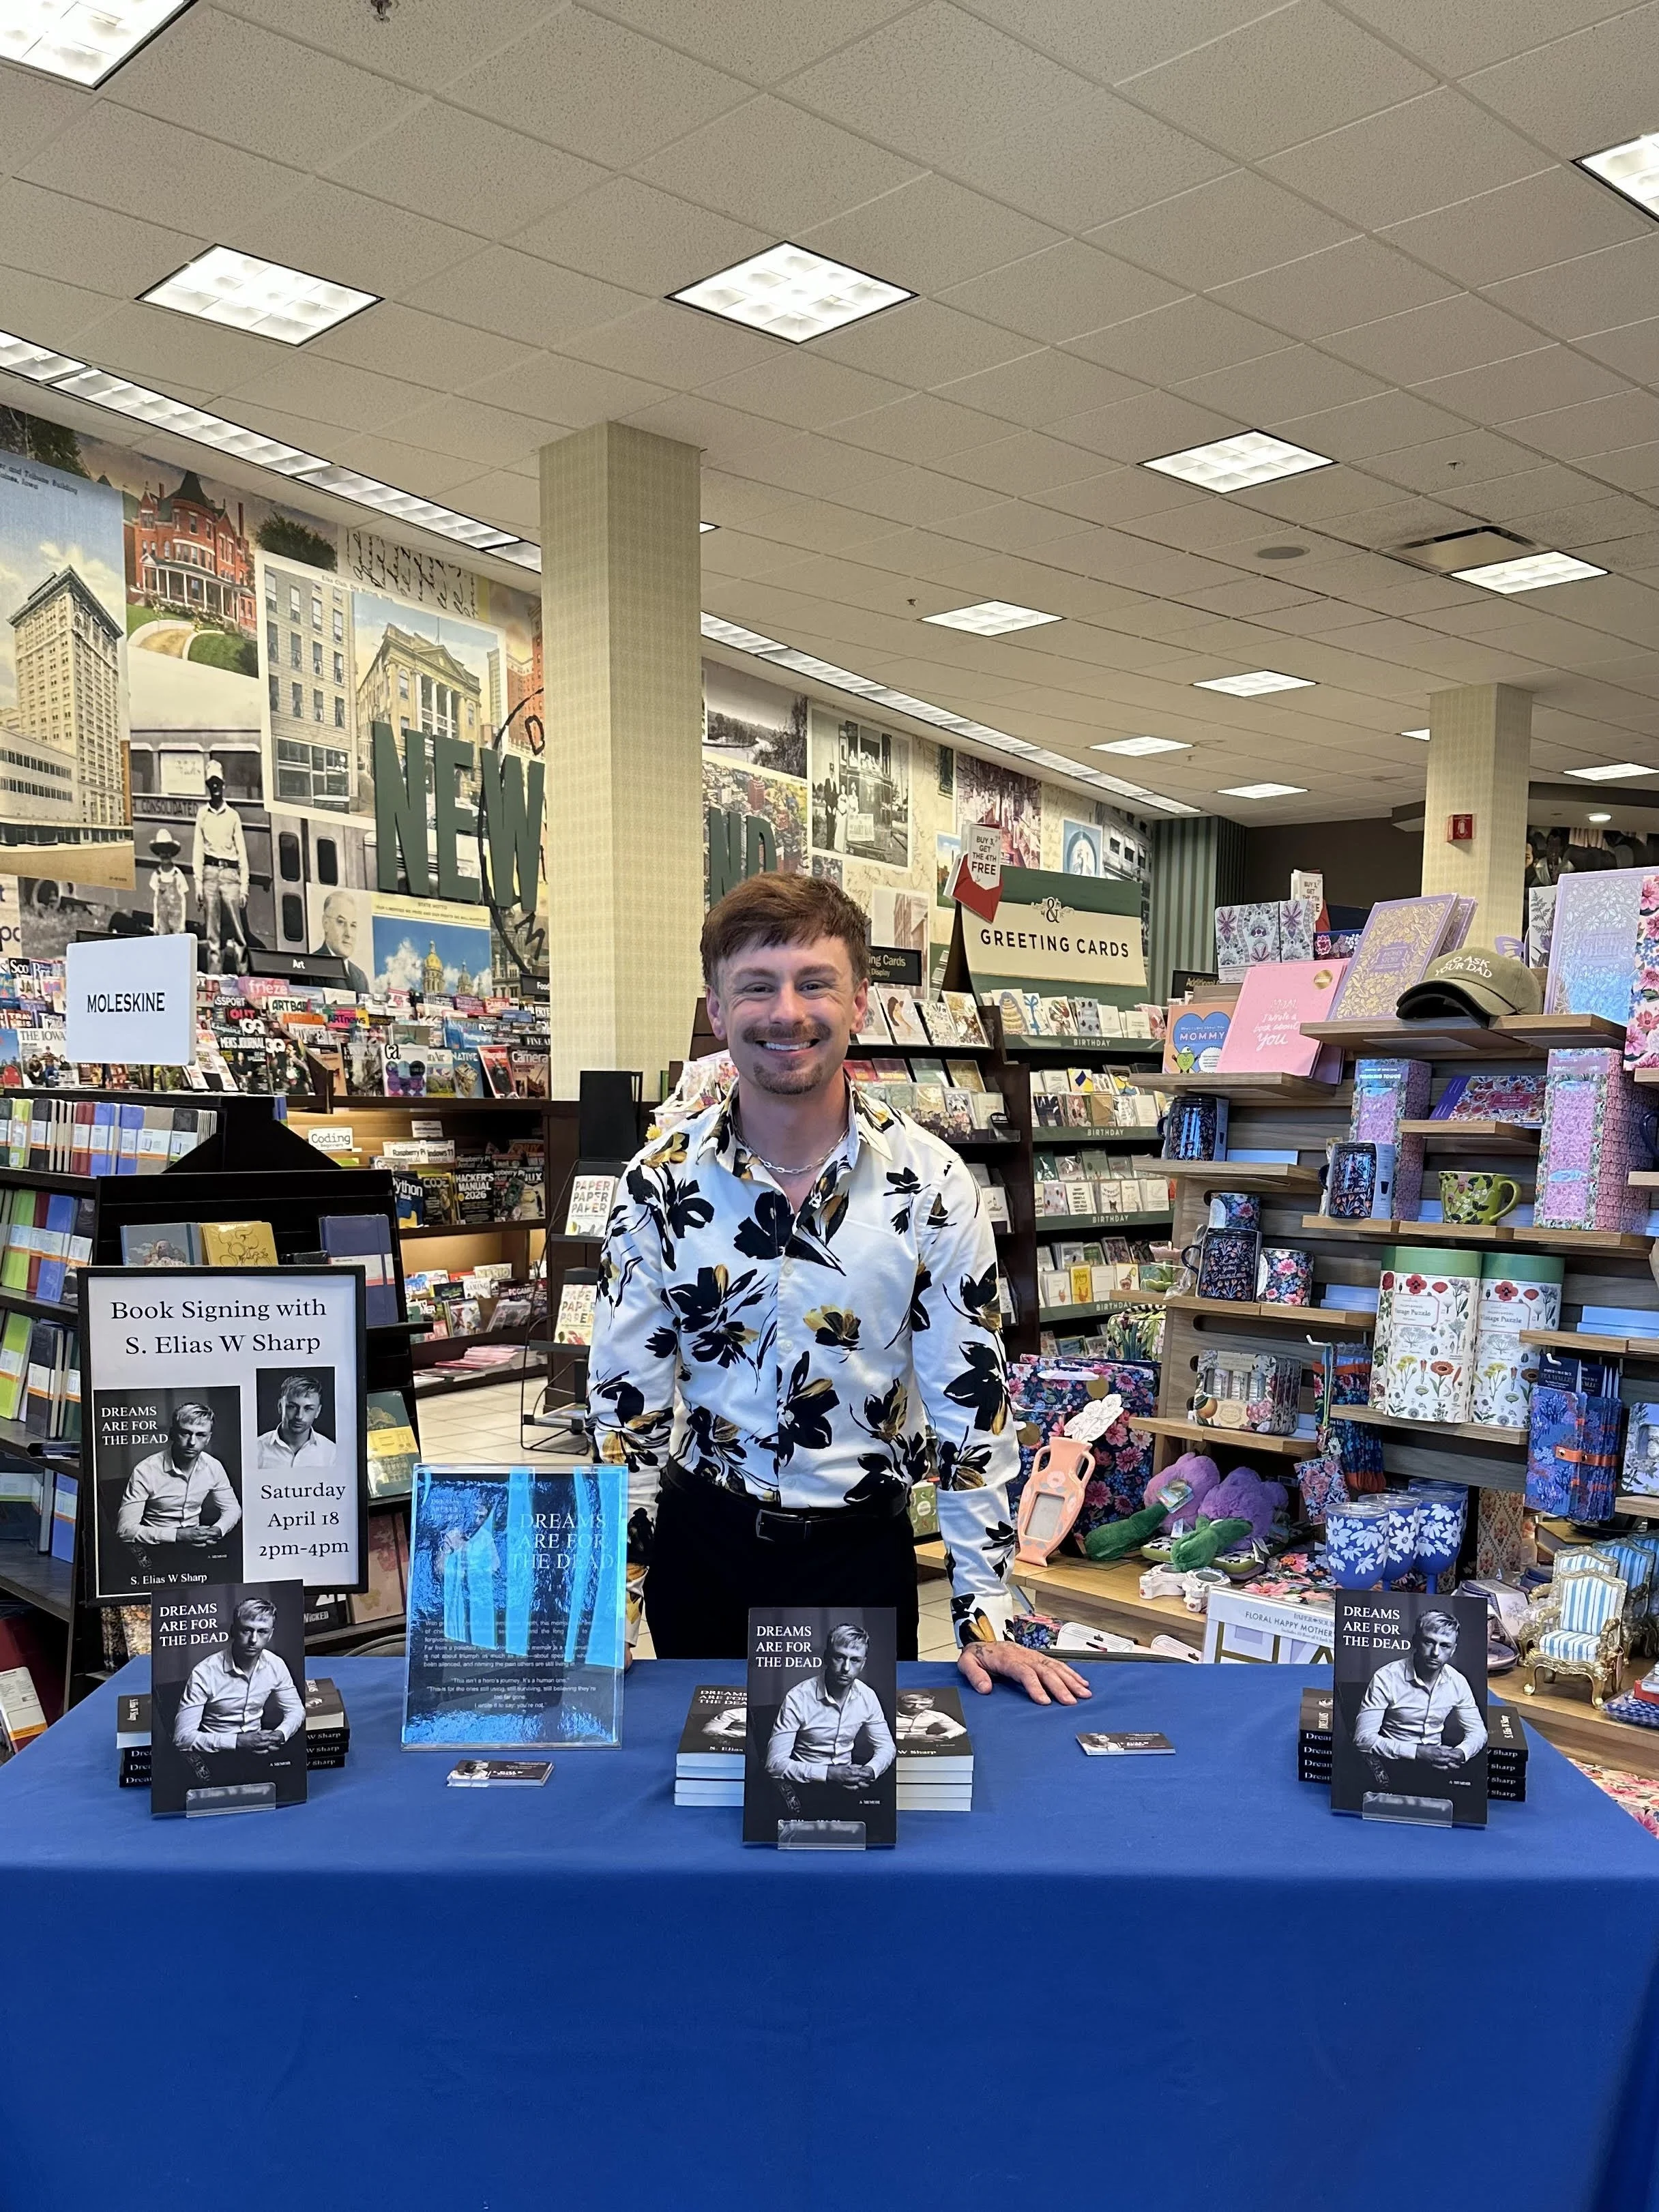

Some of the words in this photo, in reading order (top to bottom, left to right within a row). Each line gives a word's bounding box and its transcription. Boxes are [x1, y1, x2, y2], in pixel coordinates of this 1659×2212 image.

[142, 799, 198, 816] CONSOLIDATED
[373, 720, 545, 911] NEW
[976, 835, 989, 844] BUY
[989, 838, 996, 847] 3,
[979, 844, 992, 853] GET
[973, 852, 984, 861] THE
[985, 853, 997, 862] 4TH
[971, 861, 997, 876] FREE
[1046, 898, 1060, 924] &
[980, 928, 1070, 953] GREETING
[1076, 938, 1129, 958] CARDS
[292, 959, 306, 970] Art
[883, 954, 907, 967] Cards
[1463, 956, 1491, 968] ASK
[871, 969, 891, 978] Display
[1435, 962, 1464, 977] YOUR
[1466, 962, 1493, 978] DAD
[248, 979, 287, 994] frieze
[87, 992, 166, 1013] MOLESKINE
[230, 1009, 255, 1020] OUT
[1272, 1021, 1300, 1031] about
[20, 1031, 40, 1041] THE
[1179, 1031, 1226, 1042] MOMMY
[238, 1037, 265, 1049] JOURNAL
[1073, 1038, 1111, 1047] BIRTHDAY
[452, 1052, 479, 1061] NATIVE
[512, 1051, 548, 1063] Camera
[1087, 1128, 1124, 1137] BIRTHDAY
[311, 1133, 351, 1145] Coding
[393, 1149, 420, 1157] Raspberry
[423, 1177, 450, 1189] CODE
[456, 1173, 495, 1183] HACKER'S
[458, 1182, 492, 1192] MANUAL
[575, 1180, 611, 1192] PAPER
[465, 1192, 487, 1200] 2026
[573, 1192, 608, 1203] PAPER
[571, 1203, 607, 1214] PAPER
[1092, 1215, 1129, 1224] BIRTHDAY
[111, 1301, 174, 1321] Book
[182, 1299, 270, 1322] Signing
[276, 1298, 327, 1316] with
[1096, 1301, 1132, 1311] BIRTHDAY
[1411, 1308, 1431, 1317] Puzzle
[1480, 1314, 1499, 1323] Vintage
[1501, 1316, 1522, 1325] Puzzle
[126, 1336, 147, 1355] S.
[156, 1335, 213, 1354] Elias
[218, 1335, 246, 1353] W
[252, 1333, 321, 1354] Sharp
[1551, 1374, 1576, 1384] WALLET
[101, 1406, 158, 1418] DREAMS
[102, 1421, 128, 1432] ARE
[132, 1419, 158, 1431] FOR
[102, 1435, 129, 1446] THE
[132, 1434, 168, 1445] DEAD
[261, 1482, 347, 1501] Saturday
[267, 1511, 317, 1530] April
[322, 1511, 340, 1525] 18
[520, 1513, 606, 1529] DREAMS
[519, 1533, 560, 1548] ARE
[567, 1533, 606, 1549] FOR
[259, 1541, 350, 1560] 2pm-4pm
[513, 1553, 550, 1569] THE
[557, 1553, 613, 1569] DEAD
[130, 1576, 140, 1586] S.
[143, 1574, 166, 1585] Elias
[168, 1574, 179, 1584] W
[181, 1573, 207, 1584] Sharp
[160, 1603, 218, 1618] DREAMS
[1343, 1606, 1400, 1620] DREAMS
[1293, 1613, 1313, 1623] PAPER
[160, 1619, 188, 1632] ARE
[190, 1618, 218, 1630] FOR
[1245, 1611, 1272, 1624] FLORAL
[1274, 1618, 1298, 1630] HAPPY
[1300, 1624, 1333, 1638] MOTHER
[1343, 1621, 1370, 1633] ARE
[1373, 1623, 1400, 1636] FOR
[757, 1625, 812, 1637] DREAMS
[160, 1634, 187, 1647] THE
[190, 1632, 229, 1645] DEAD
[1343, 1635, 1370, 1648] THE
[1372, 1637, 1411, 1651] DEAD
[756, 1641, 783, 1653] ARE
[786, 1641, 812, 1653] FOR
[756, 1657, 782, 1668] THE
[784, 1657, 822, 1668] DEAD
[1493, 1750, 1518, 1758] Sharp
[1491, 1764, 1516, 1772] Sharp
[1491, 1777, 1516, 1785] Sharp
[1491, 1790, 1516, 1798] Sharp
